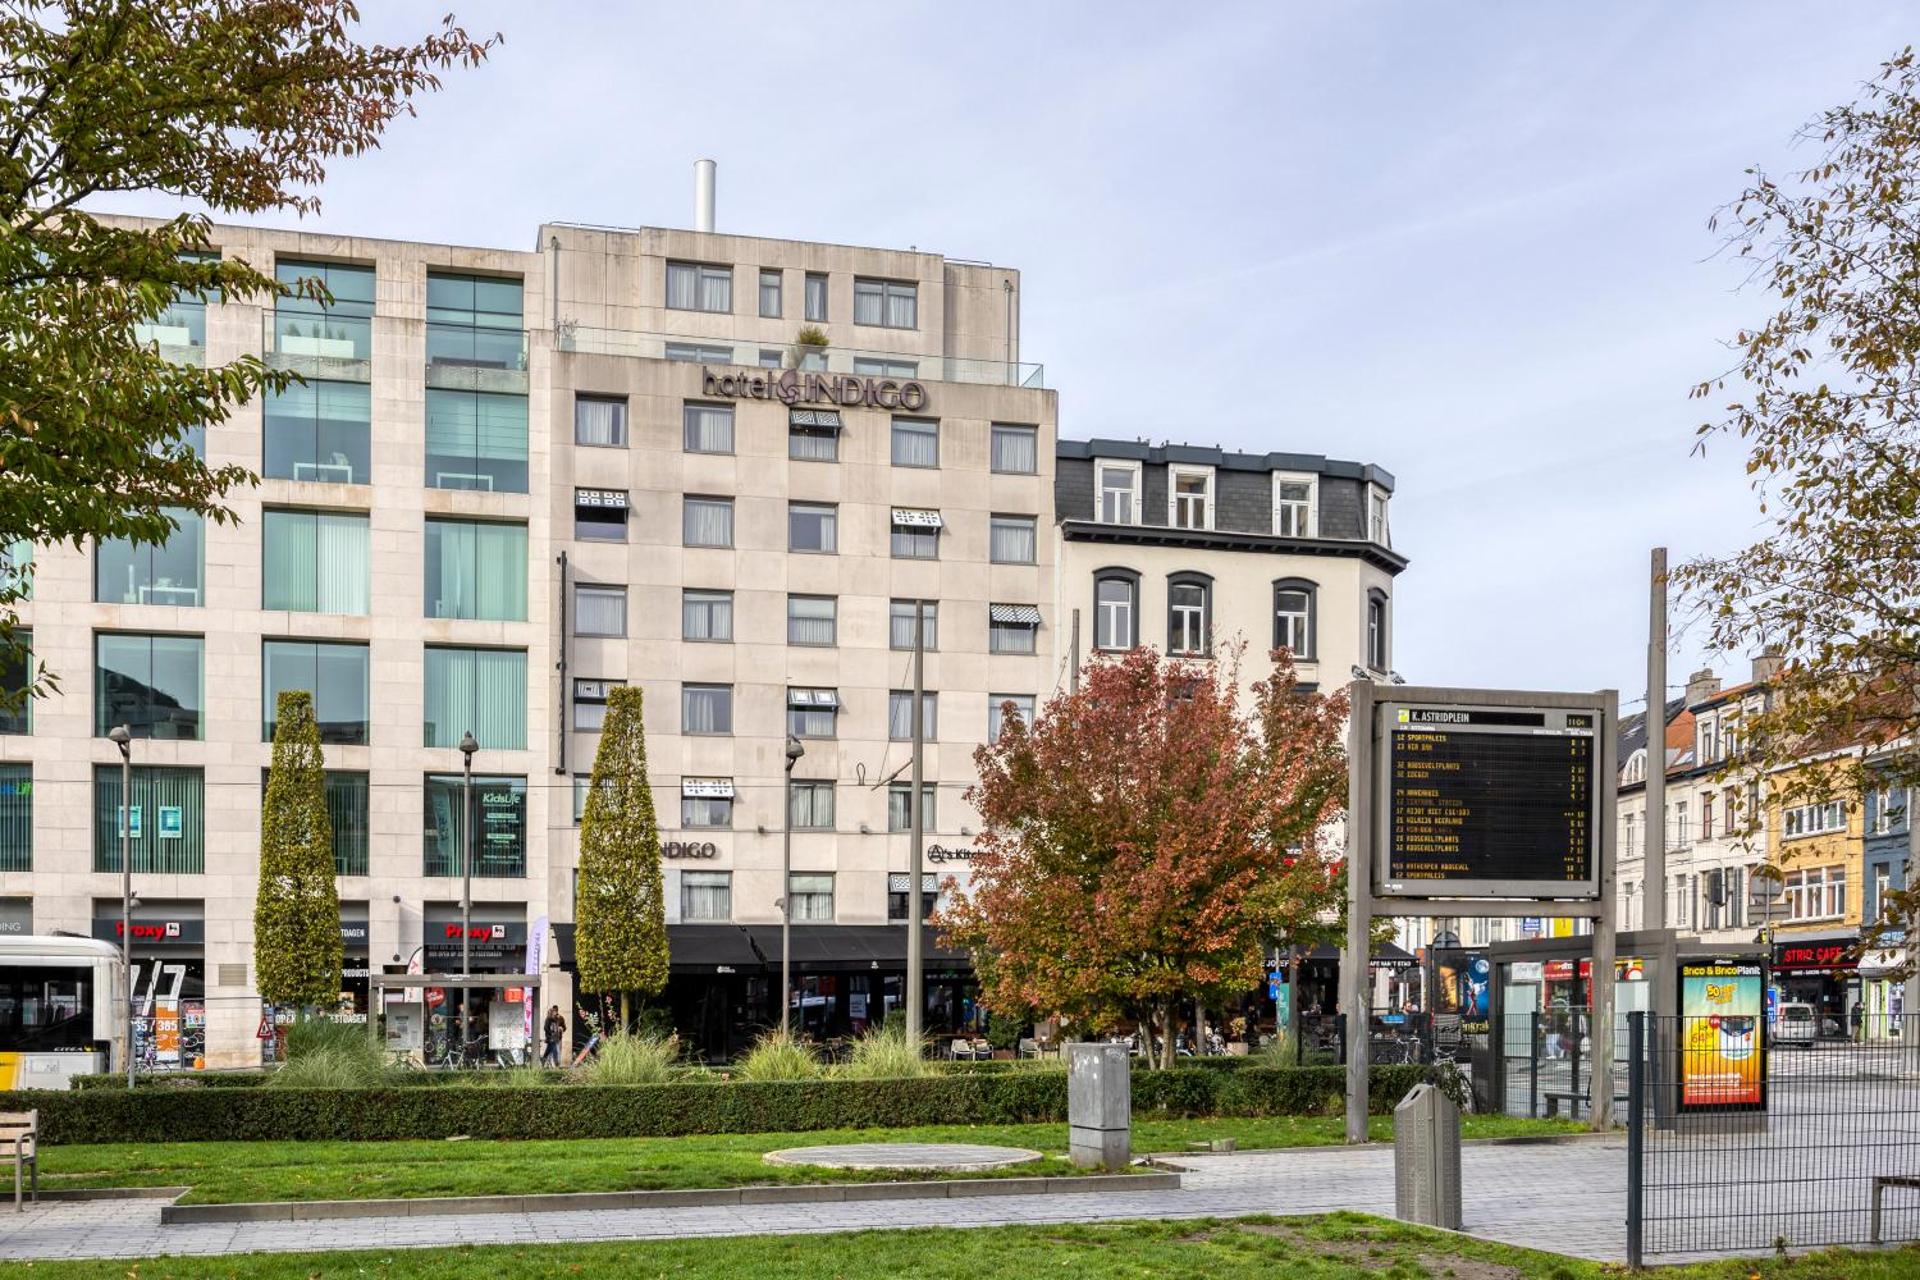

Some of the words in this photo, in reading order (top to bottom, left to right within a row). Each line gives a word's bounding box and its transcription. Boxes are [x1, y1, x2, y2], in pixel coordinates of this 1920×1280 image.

[703, 366, 773, 400] hotel
[804, 374, 928, 411] INDIGO
[1412, 711, 1420, 722] K.
[1421, 712, 1470, 723] ASTRIDPLEIN
[661, 841, 717, 859] NDIGO
[0, 921, 22, 932] ING
[340, 928, 365, 938] TDAGEN
[1682, 966, 1705, 976] Brico
